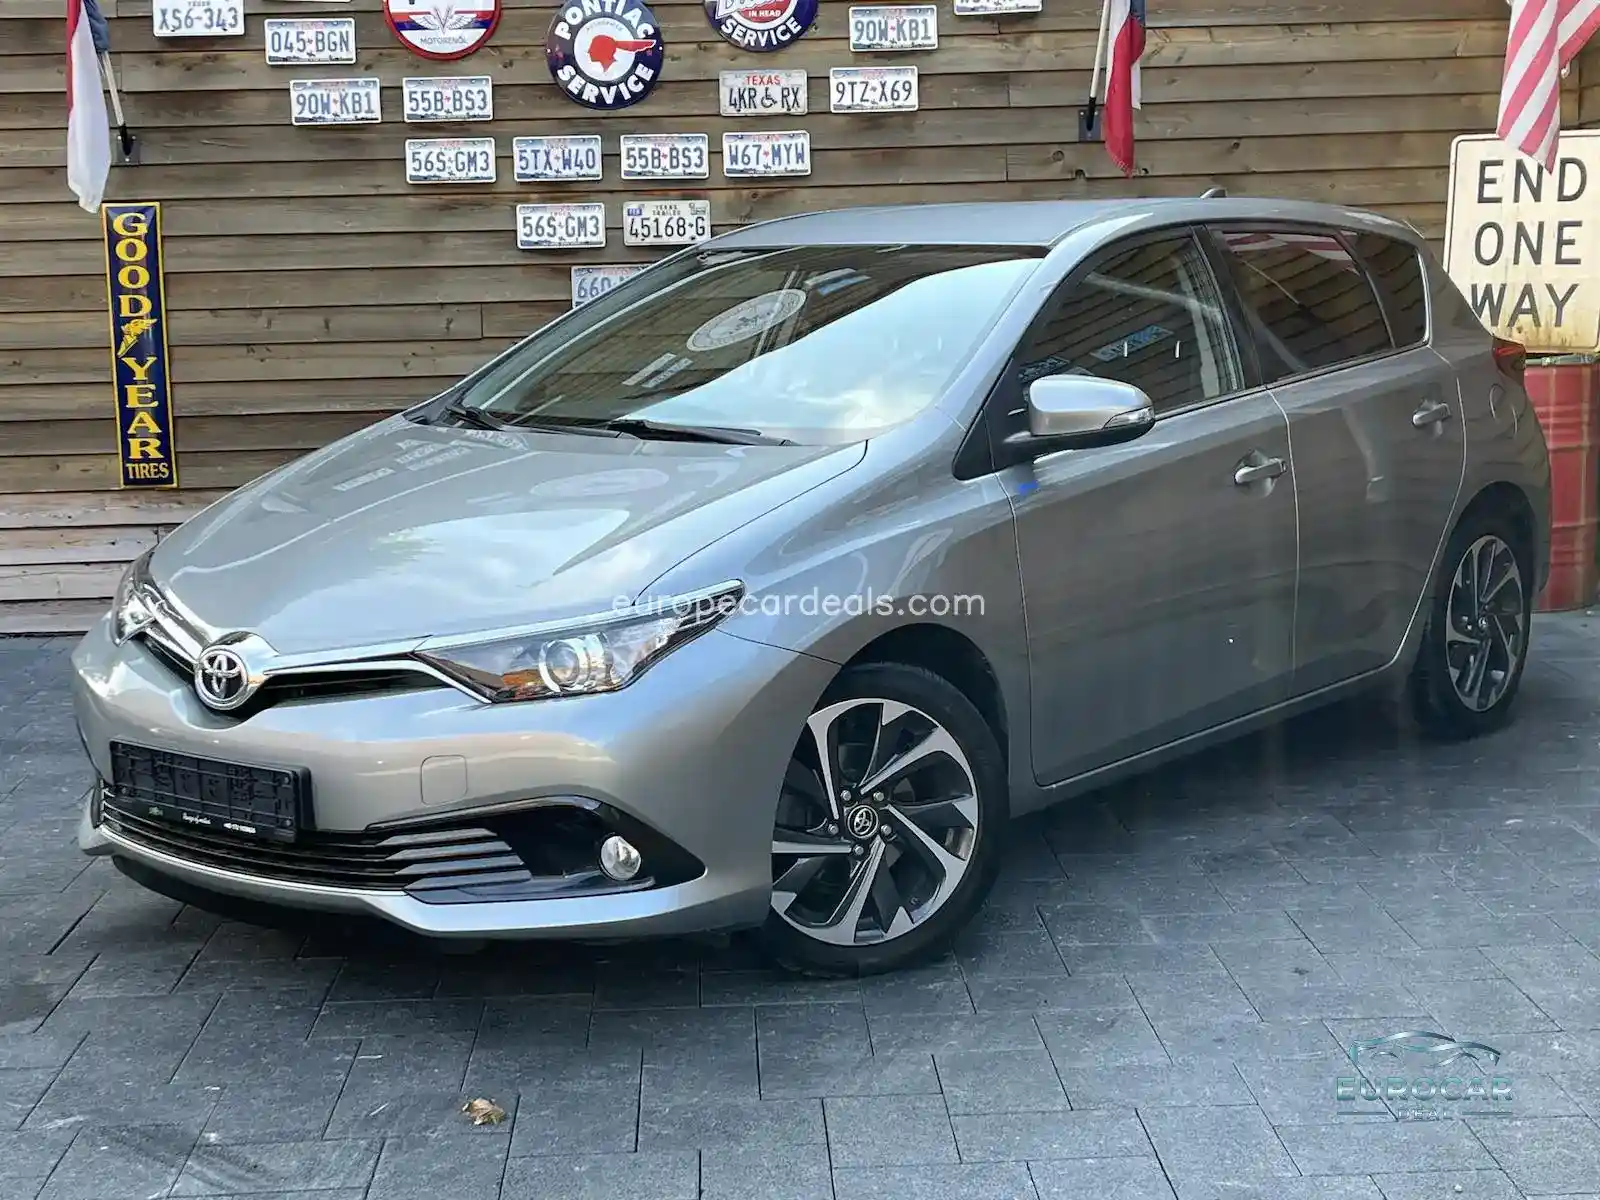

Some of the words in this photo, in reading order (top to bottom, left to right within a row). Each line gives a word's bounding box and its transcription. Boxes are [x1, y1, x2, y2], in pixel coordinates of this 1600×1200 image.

[554, 0, 655, 40] PONTIAC
[759, 9, 782, 17] HEAD
[721, 17, 802, 46] SERVICE
[556, 63, 655, 105] SERVICE
[745, 75, 781, 86] TEXAS
[1477, 157, 1588, 204] END
[630, 217, 686, 240] 45168
[1475, 220, 1583, 266] ONE
[1470, 282, 1580, 327] WAY
[126, 462, 170, 479] TIRES
